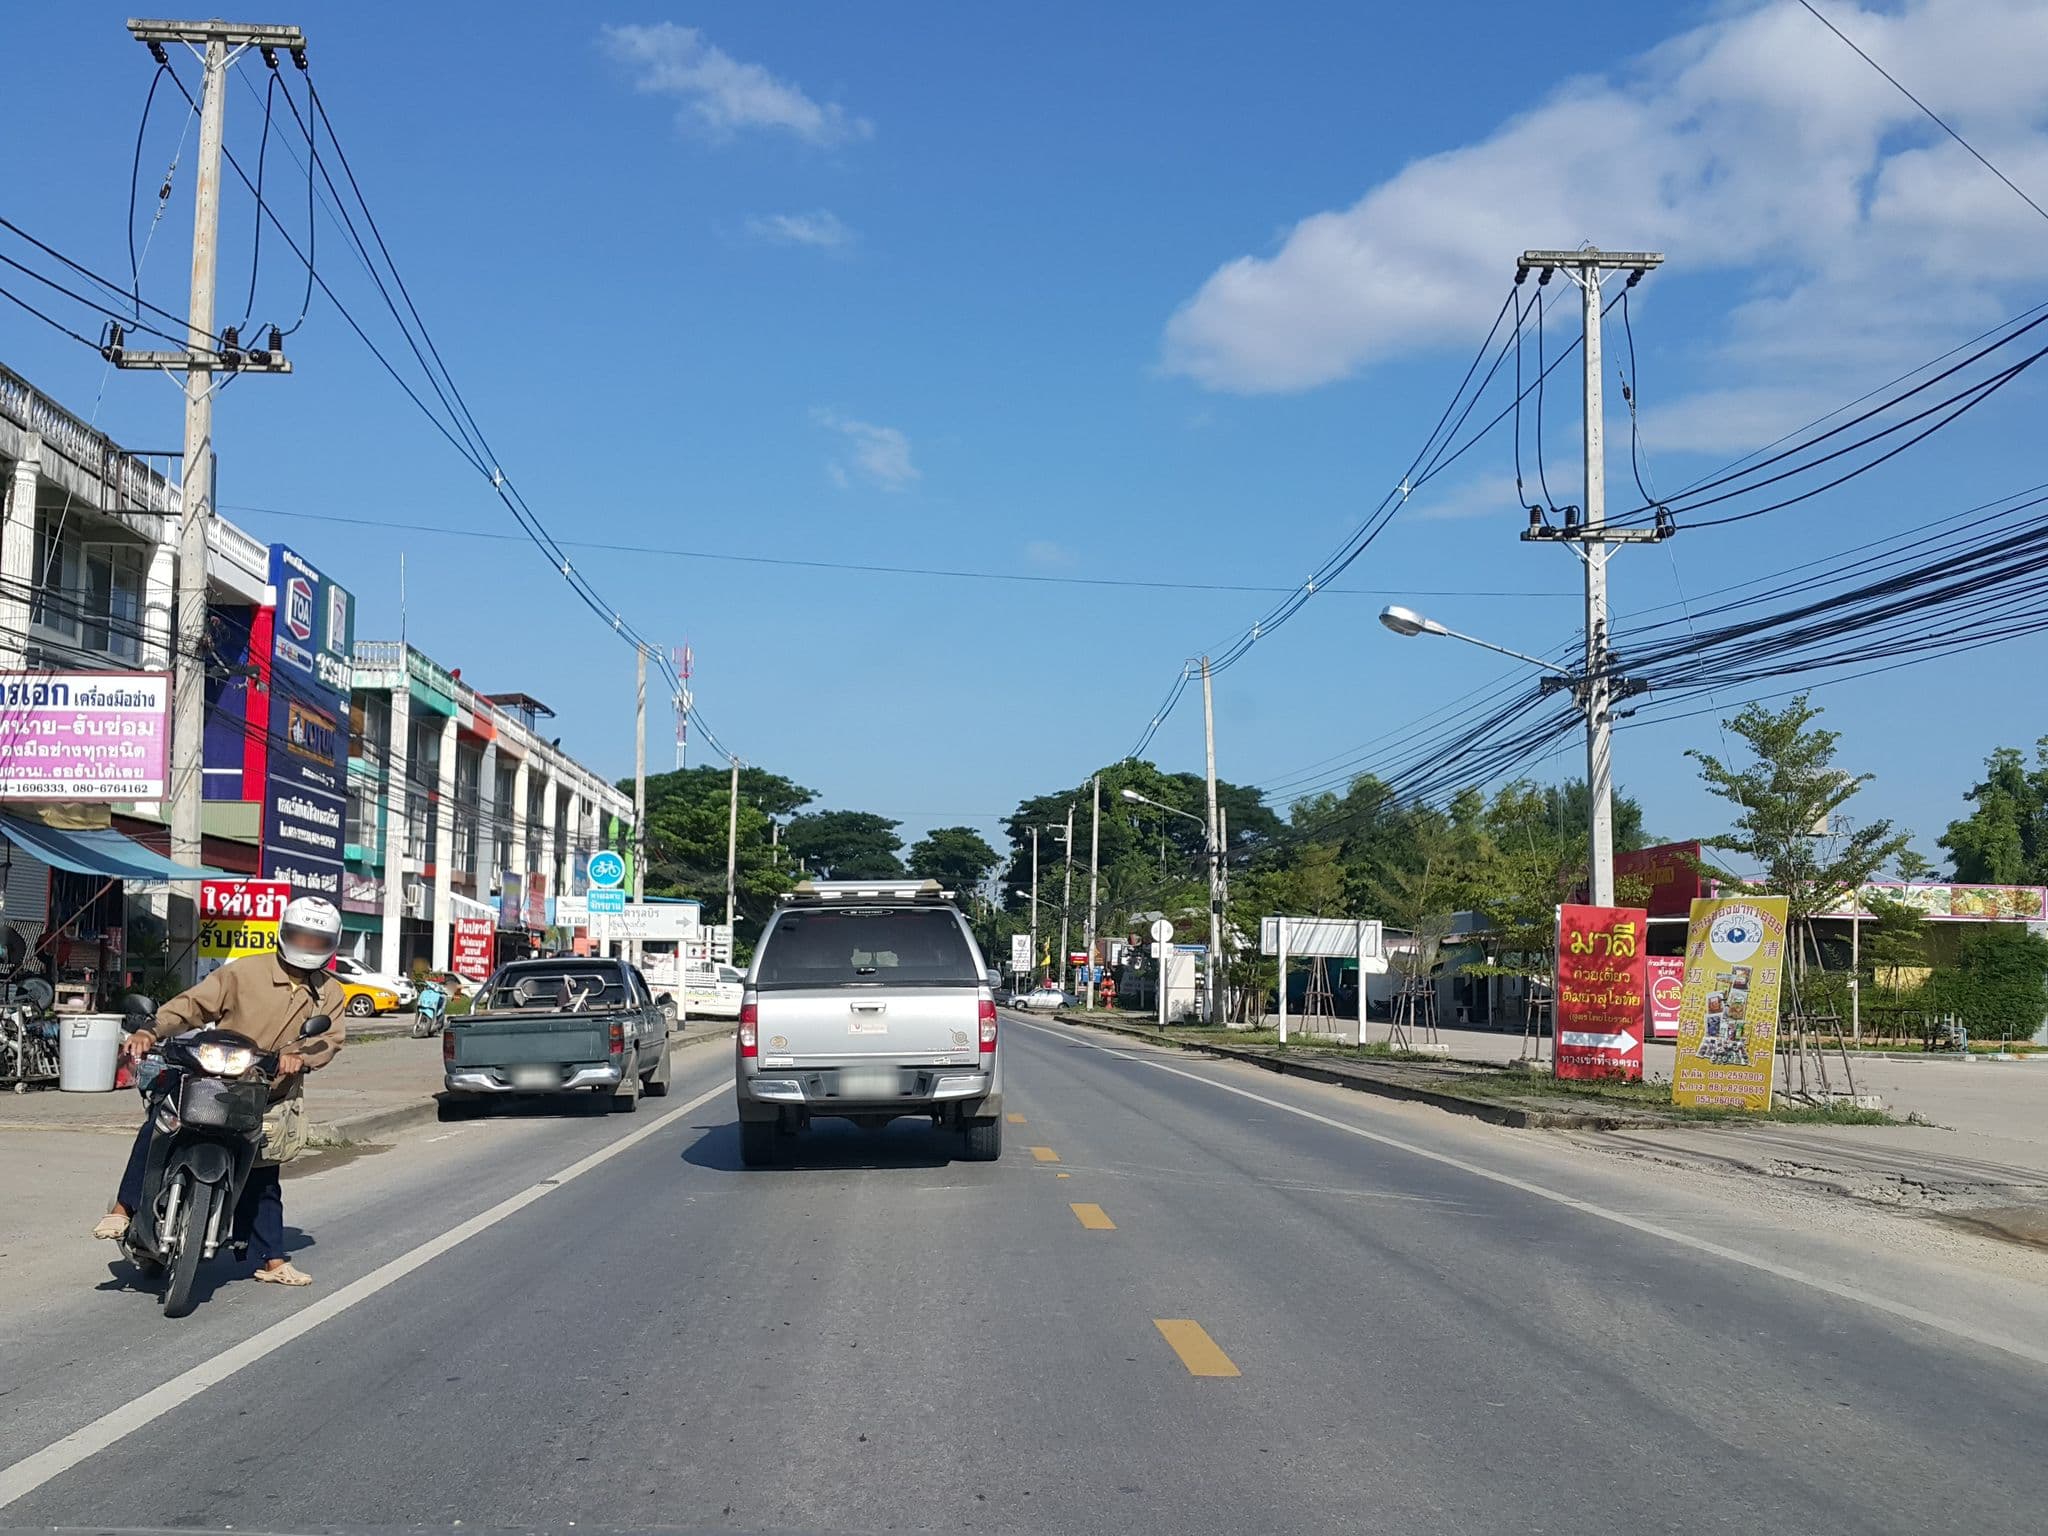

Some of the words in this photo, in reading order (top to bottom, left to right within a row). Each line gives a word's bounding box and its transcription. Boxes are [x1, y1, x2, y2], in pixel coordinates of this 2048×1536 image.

[293, 594, 310, 625] TOA
[75, 685, 155, 707] เครื่องมือช่าง
[73, 784, 148, 793] 080-6764162
[203, 884, 288, 917] ให้เช่า
[591, 900, 621, 911] จักรยาน
[200, 922, 277, 949] รับซ่อม
[1570, 921, 1635, 957] มาลี
[1562, 986, 1641, 1010] ต้มยำสุโขทัย
[1656, 986, 1682, 1000] มาลี
[1561, 1052, 1640, 1068] ทางเข้าที่จอดรถ
